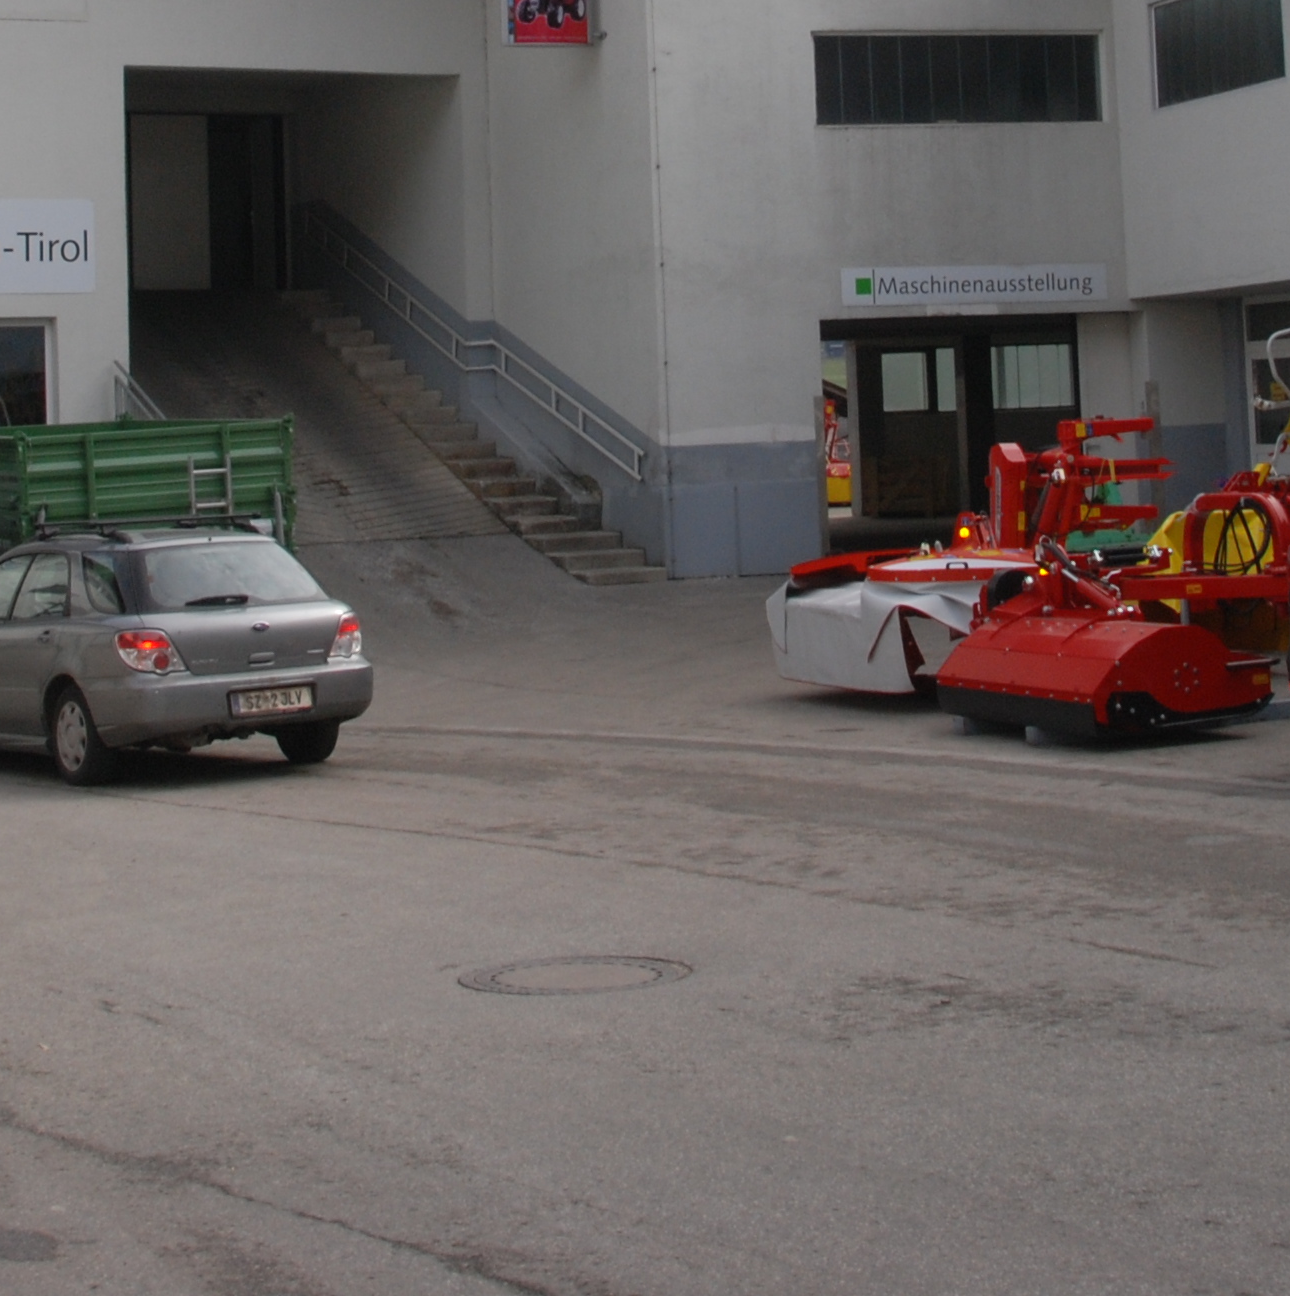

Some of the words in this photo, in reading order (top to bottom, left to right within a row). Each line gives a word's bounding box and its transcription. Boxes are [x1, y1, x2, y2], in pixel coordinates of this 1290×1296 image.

[877, 271, 1094, 296] Maschinenausstellung
[245, 695, 261, 710] SZ
[270, 693, 278, 708] 2
